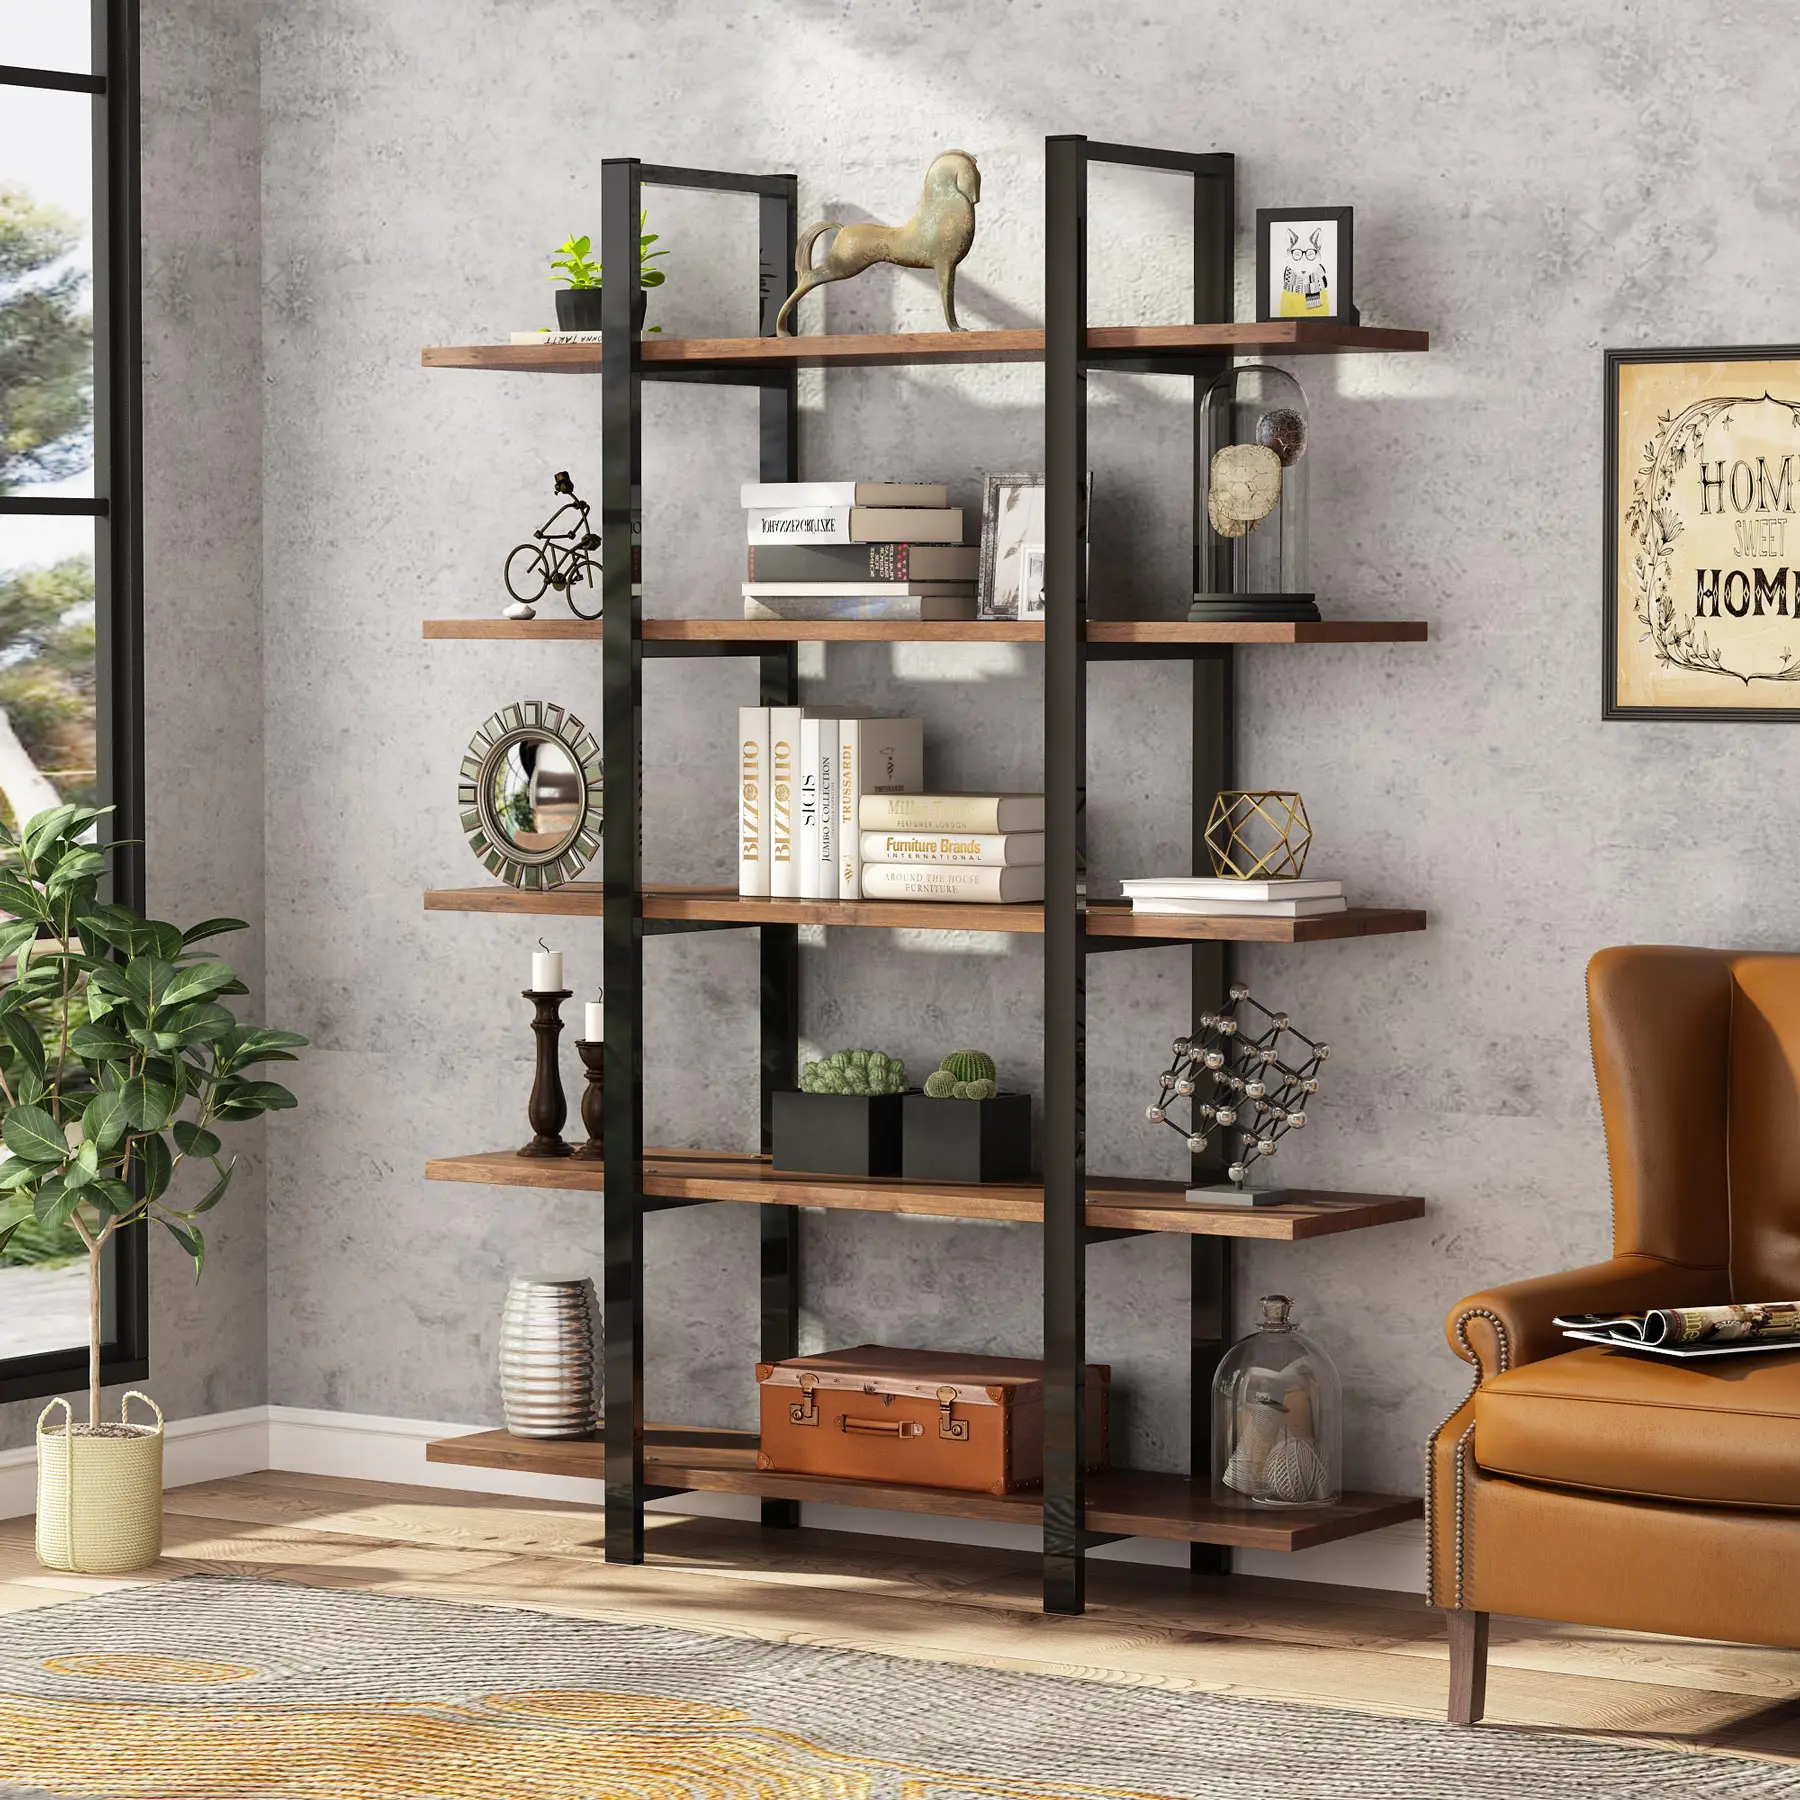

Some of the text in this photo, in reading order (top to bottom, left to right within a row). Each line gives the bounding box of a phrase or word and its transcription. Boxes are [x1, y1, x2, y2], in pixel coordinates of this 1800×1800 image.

[1698, 454, 1800, 515] HOM
[1733, 518, 1788, 557] SWEET
[1694, 567, 1800, 619] HOM
[802, 774, 815, 826] SICIS
[821, 756, 830, 823] COLLECTION
[842, 745, 853, 823] TRUSSARDI
[821, 826, 833, 862] JUMBO
[886, 837, 981, 854] Furniture Brands
[887, 853, 982, 861] INTERNATIONAL
[884, 872, 980, 884] AROUND THE HOUSE
[905, 883, 959, 894] FURNITURE
